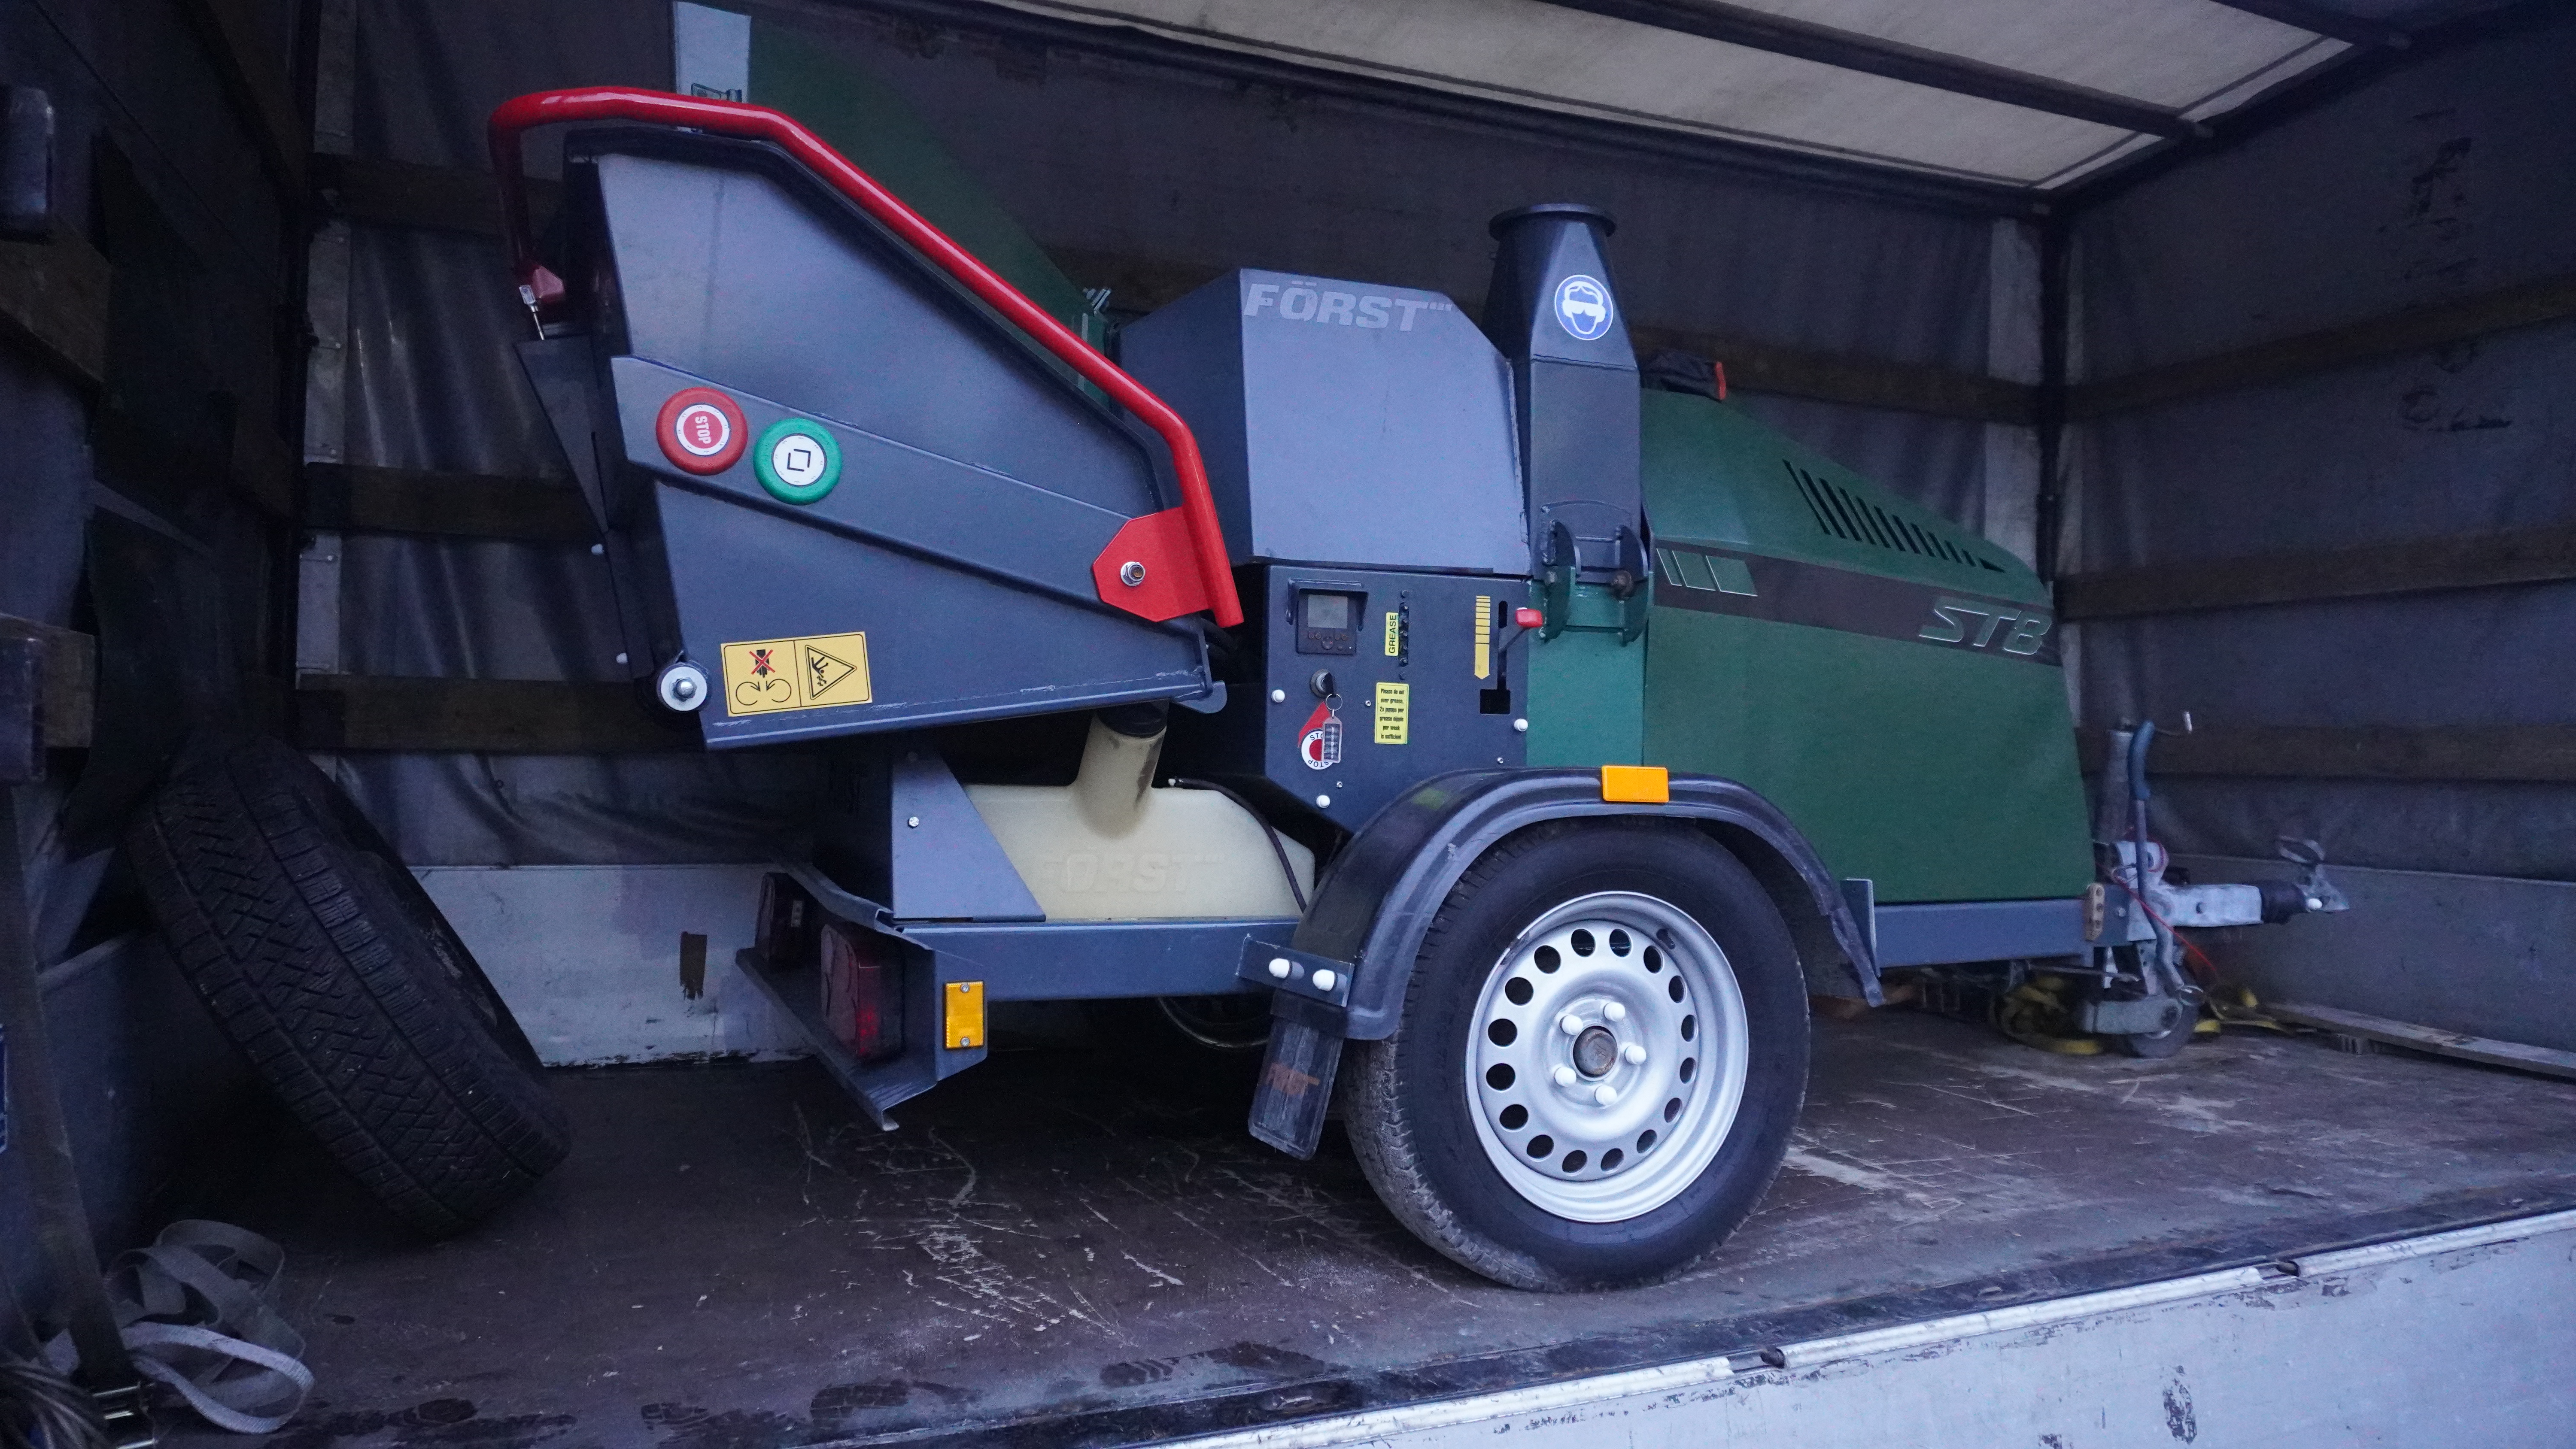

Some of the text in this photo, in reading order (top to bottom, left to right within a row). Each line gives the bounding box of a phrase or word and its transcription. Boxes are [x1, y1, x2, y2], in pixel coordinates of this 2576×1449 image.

[1244, 280, 1429, 331] FÖRST
[695, 416, 711, 444] STOP
[1918, 596, 2052, 655] ST8
